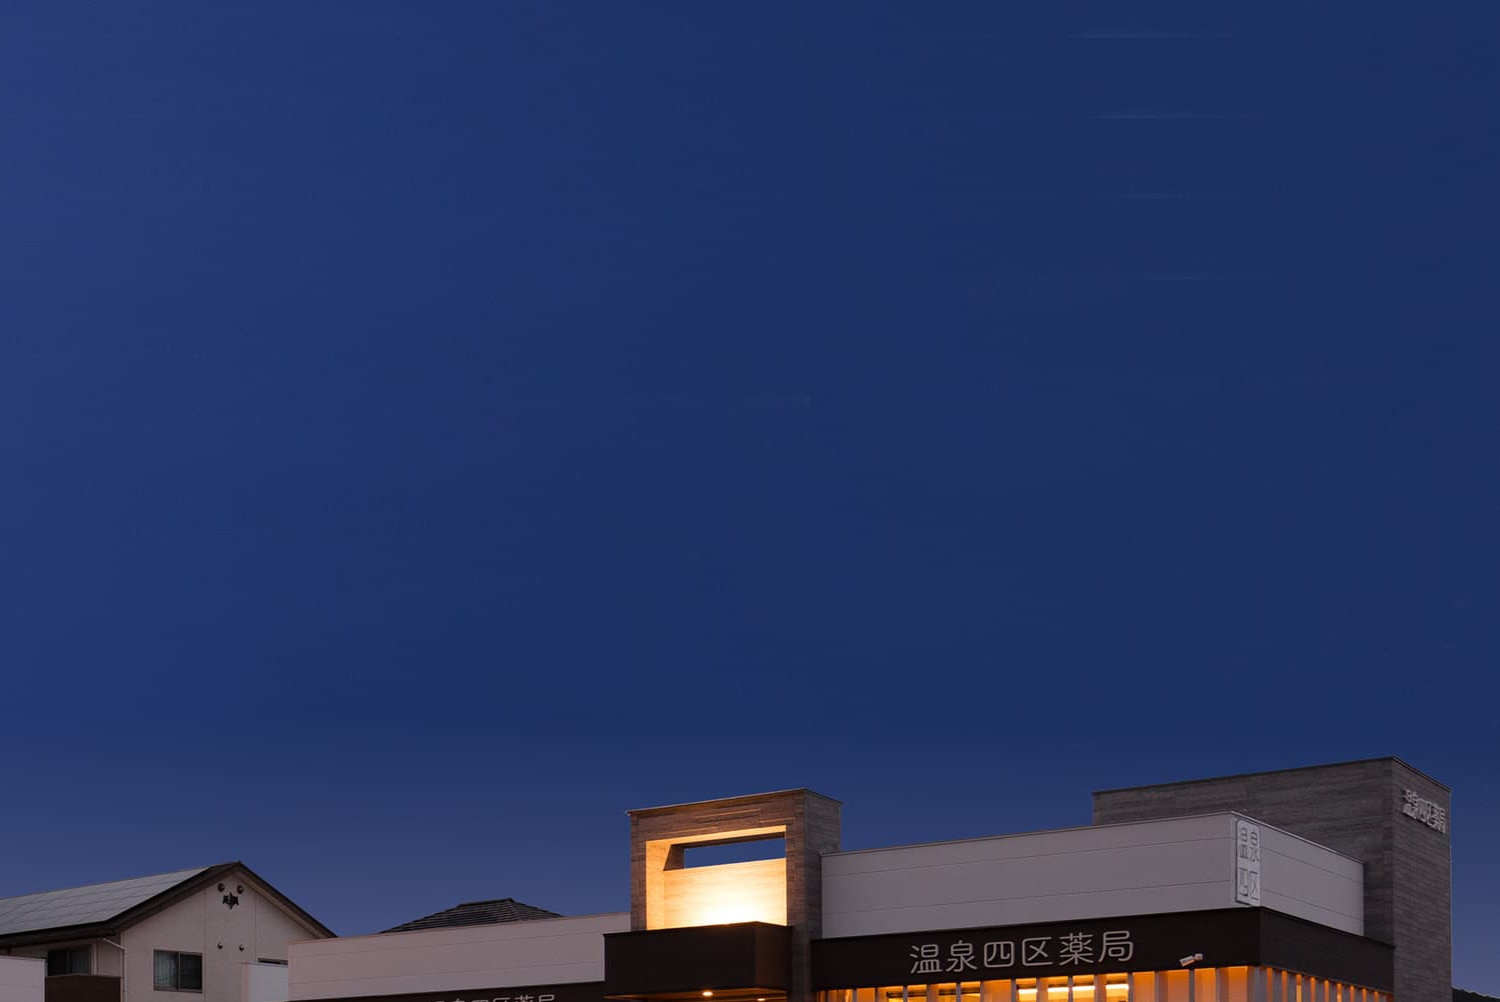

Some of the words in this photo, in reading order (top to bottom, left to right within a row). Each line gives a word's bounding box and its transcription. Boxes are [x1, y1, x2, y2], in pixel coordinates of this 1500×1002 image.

[909, 929, 1134, 975] 温泉四区薬局
